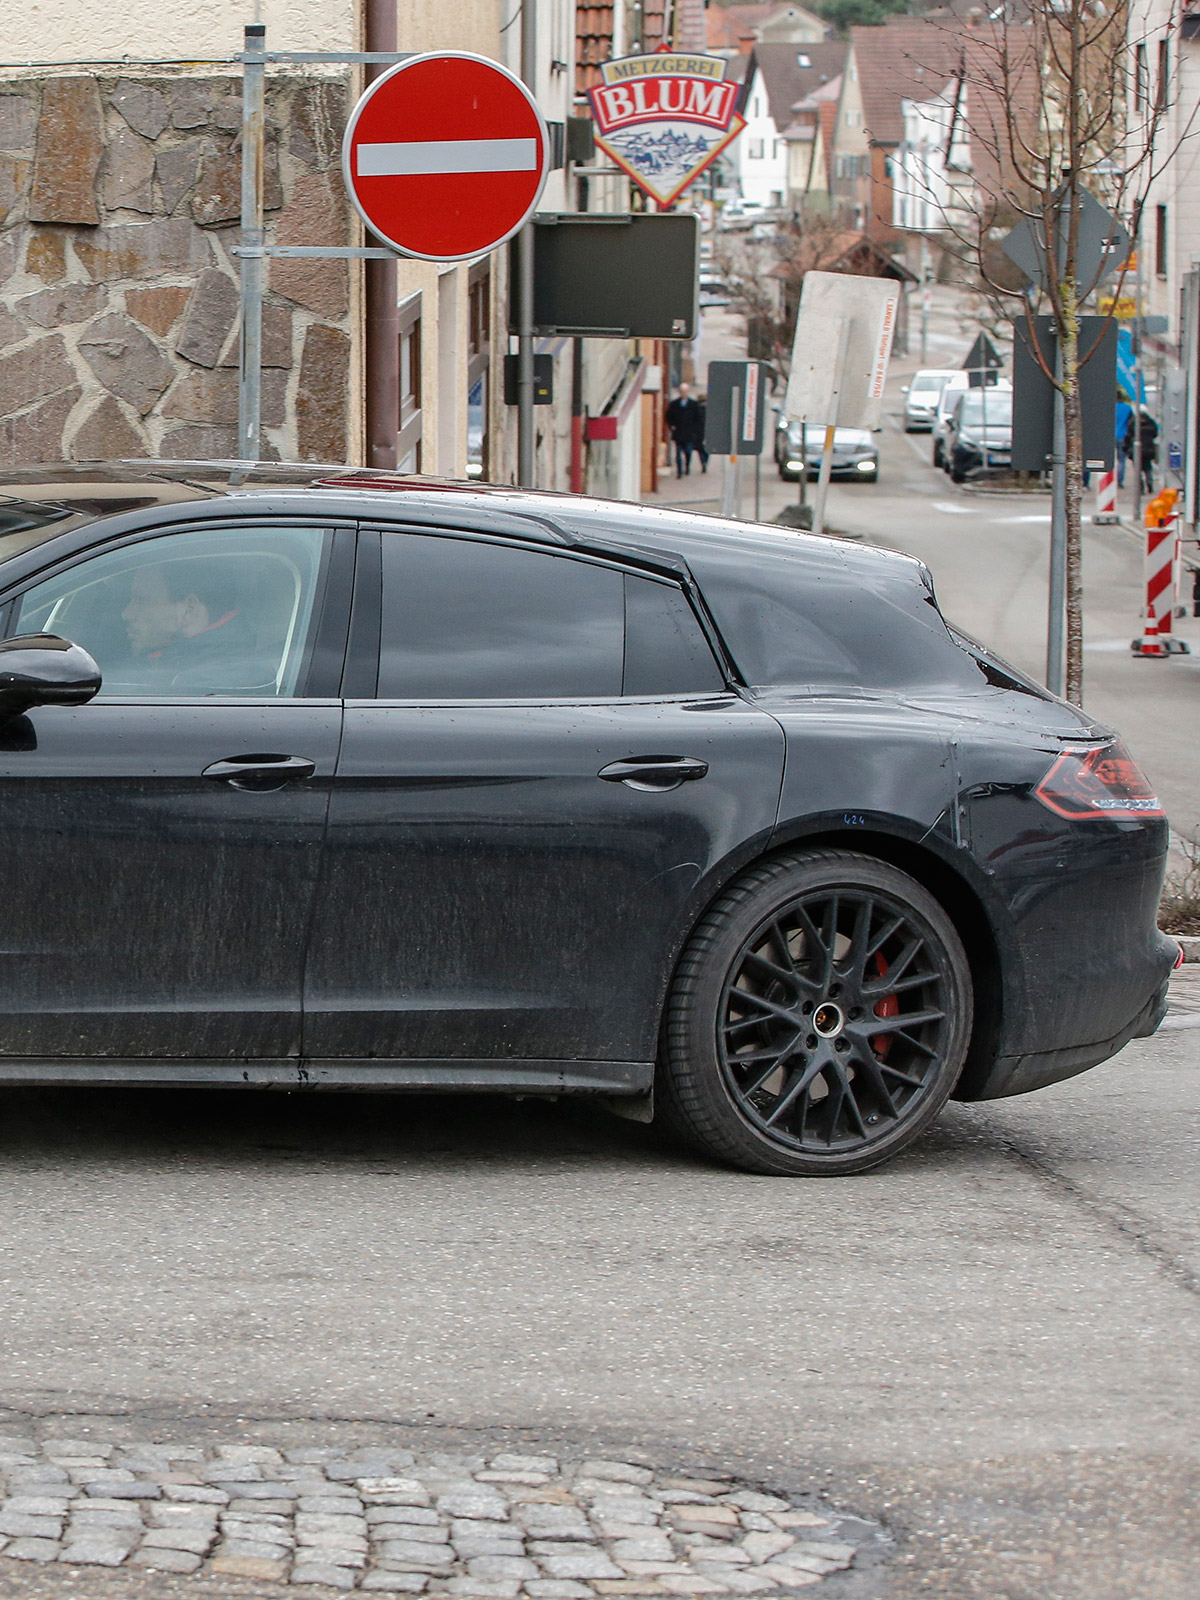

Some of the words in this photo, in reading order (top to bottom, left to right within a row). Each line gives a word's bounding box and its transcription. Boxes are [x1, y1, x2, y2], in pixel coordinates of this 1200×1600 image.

[614, 59, 716, 77] METZGEREI
[601, 80, 727, 122] BLUM
[843, 814, 865, 824] 424
